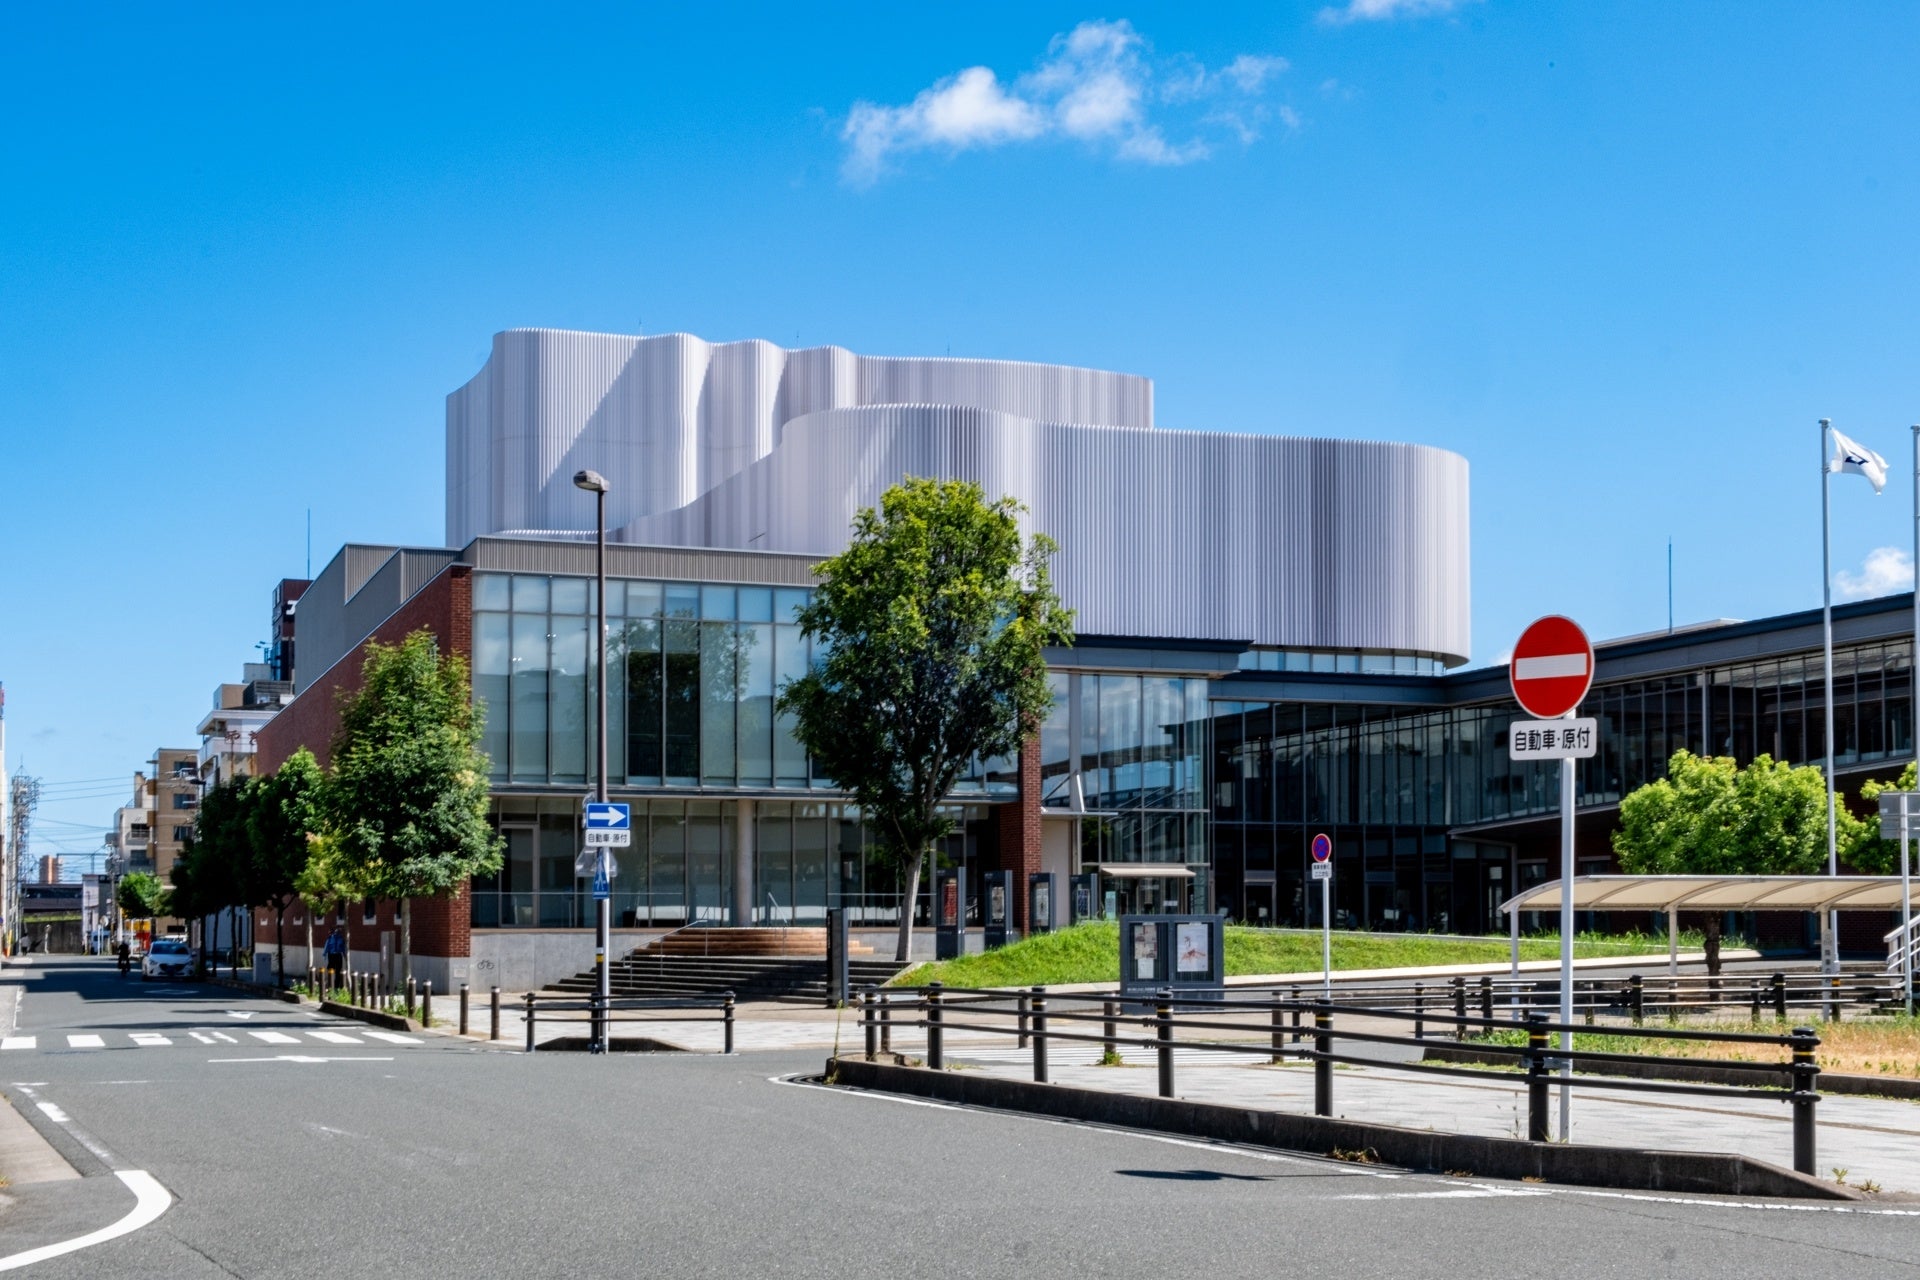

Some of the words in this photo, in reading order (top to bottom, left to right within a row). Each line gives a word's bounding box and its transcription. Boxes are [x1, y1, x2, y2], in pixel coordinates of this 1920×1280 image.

[1514, 727, 1591, 751] 自動車・原付
